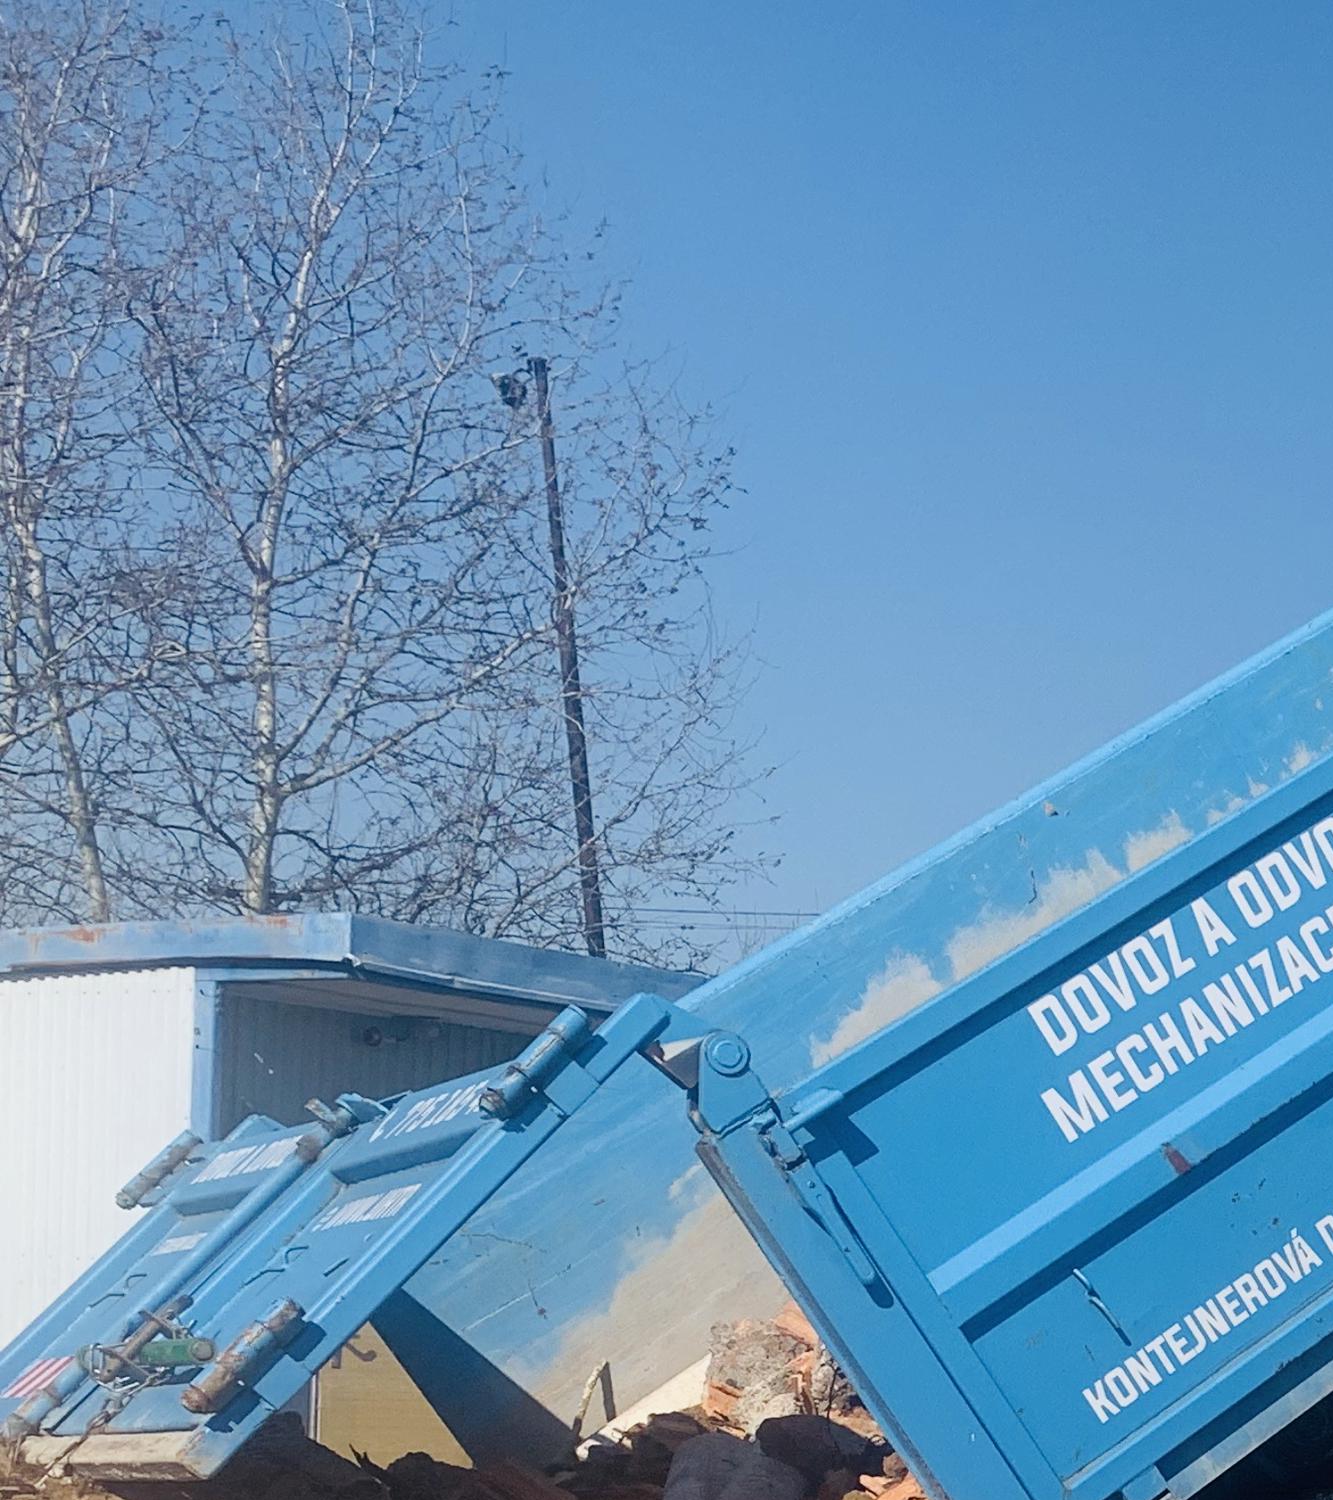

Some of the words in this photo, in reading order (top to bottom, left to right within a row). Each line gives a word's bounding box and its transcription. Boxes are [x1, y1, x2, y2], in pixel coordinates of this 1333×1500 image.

[1027, 918, 1196, 1056] DOVOZ
[1191, 897, 1236, 957] A
[1082, 1227, 1323, 1423] KONTEJNEROVÁ
